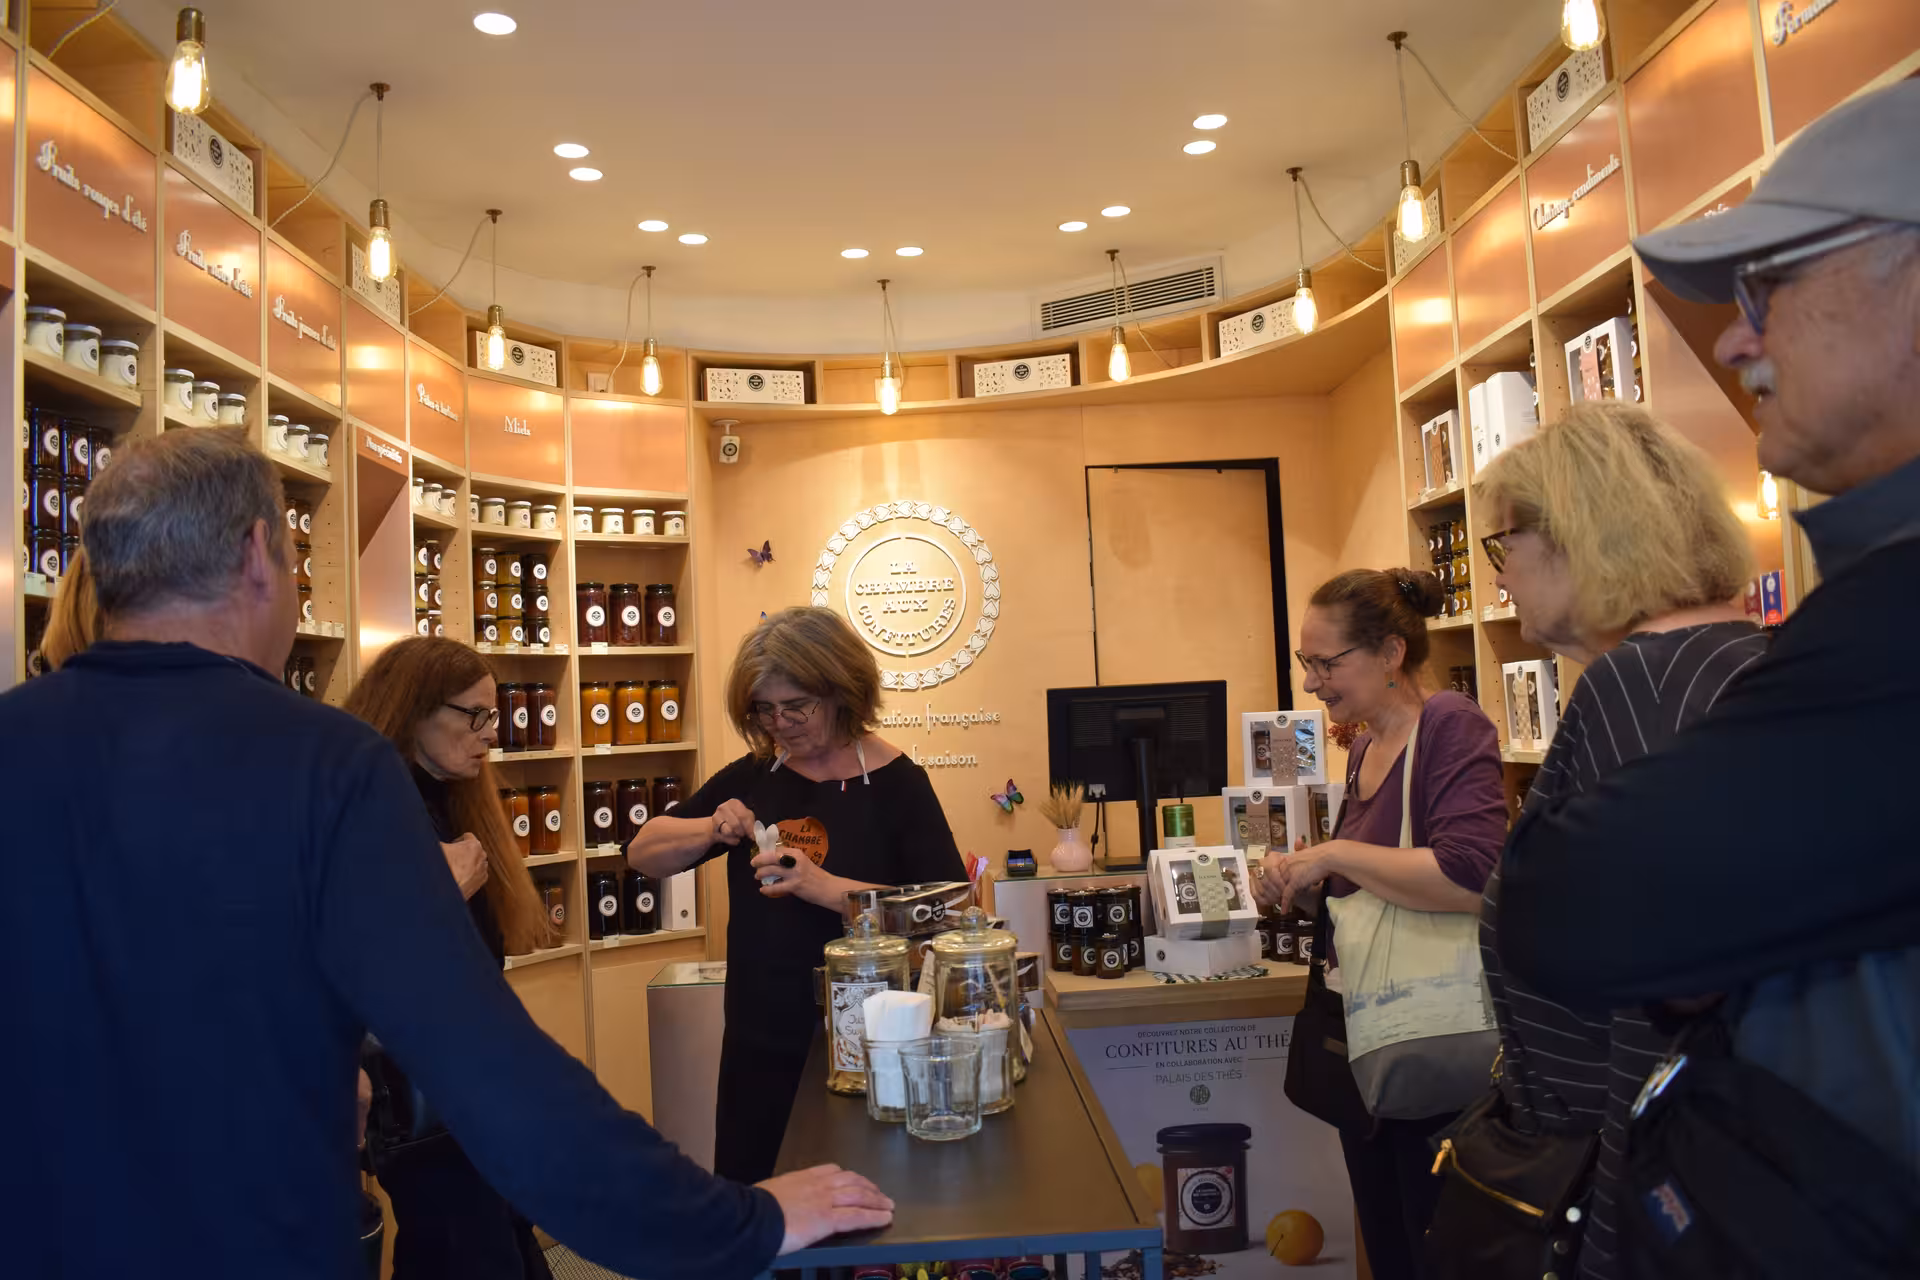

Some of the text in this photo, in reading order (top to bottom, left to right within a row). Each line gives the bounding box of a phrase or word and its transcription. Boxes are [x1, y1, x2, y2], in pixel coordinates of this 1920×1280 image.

[504, 415, 531, 436] Miels
[855, 578, 954, 596] CHAMBRE
[883, 599, 929, 614] AUX
[858, 598, 956, 646] CONFITURES
[926, 701, 1001, 735] française
[779, 829, 823, 845] CHAMBRE
[1179, 1028, 1202, 1037] NOTRE
[1204, 1025, 1246, 1034] COLLECTION
[1105, 1038, 1217, 1059] CONFITURES
[1225, 1036, 1248, 1052] AU
[1155, 1056, 1243, 1069] EN COLLABORATION AVEC
[1155, 1068, 1243, 1085] PALAIS DES THÉS
